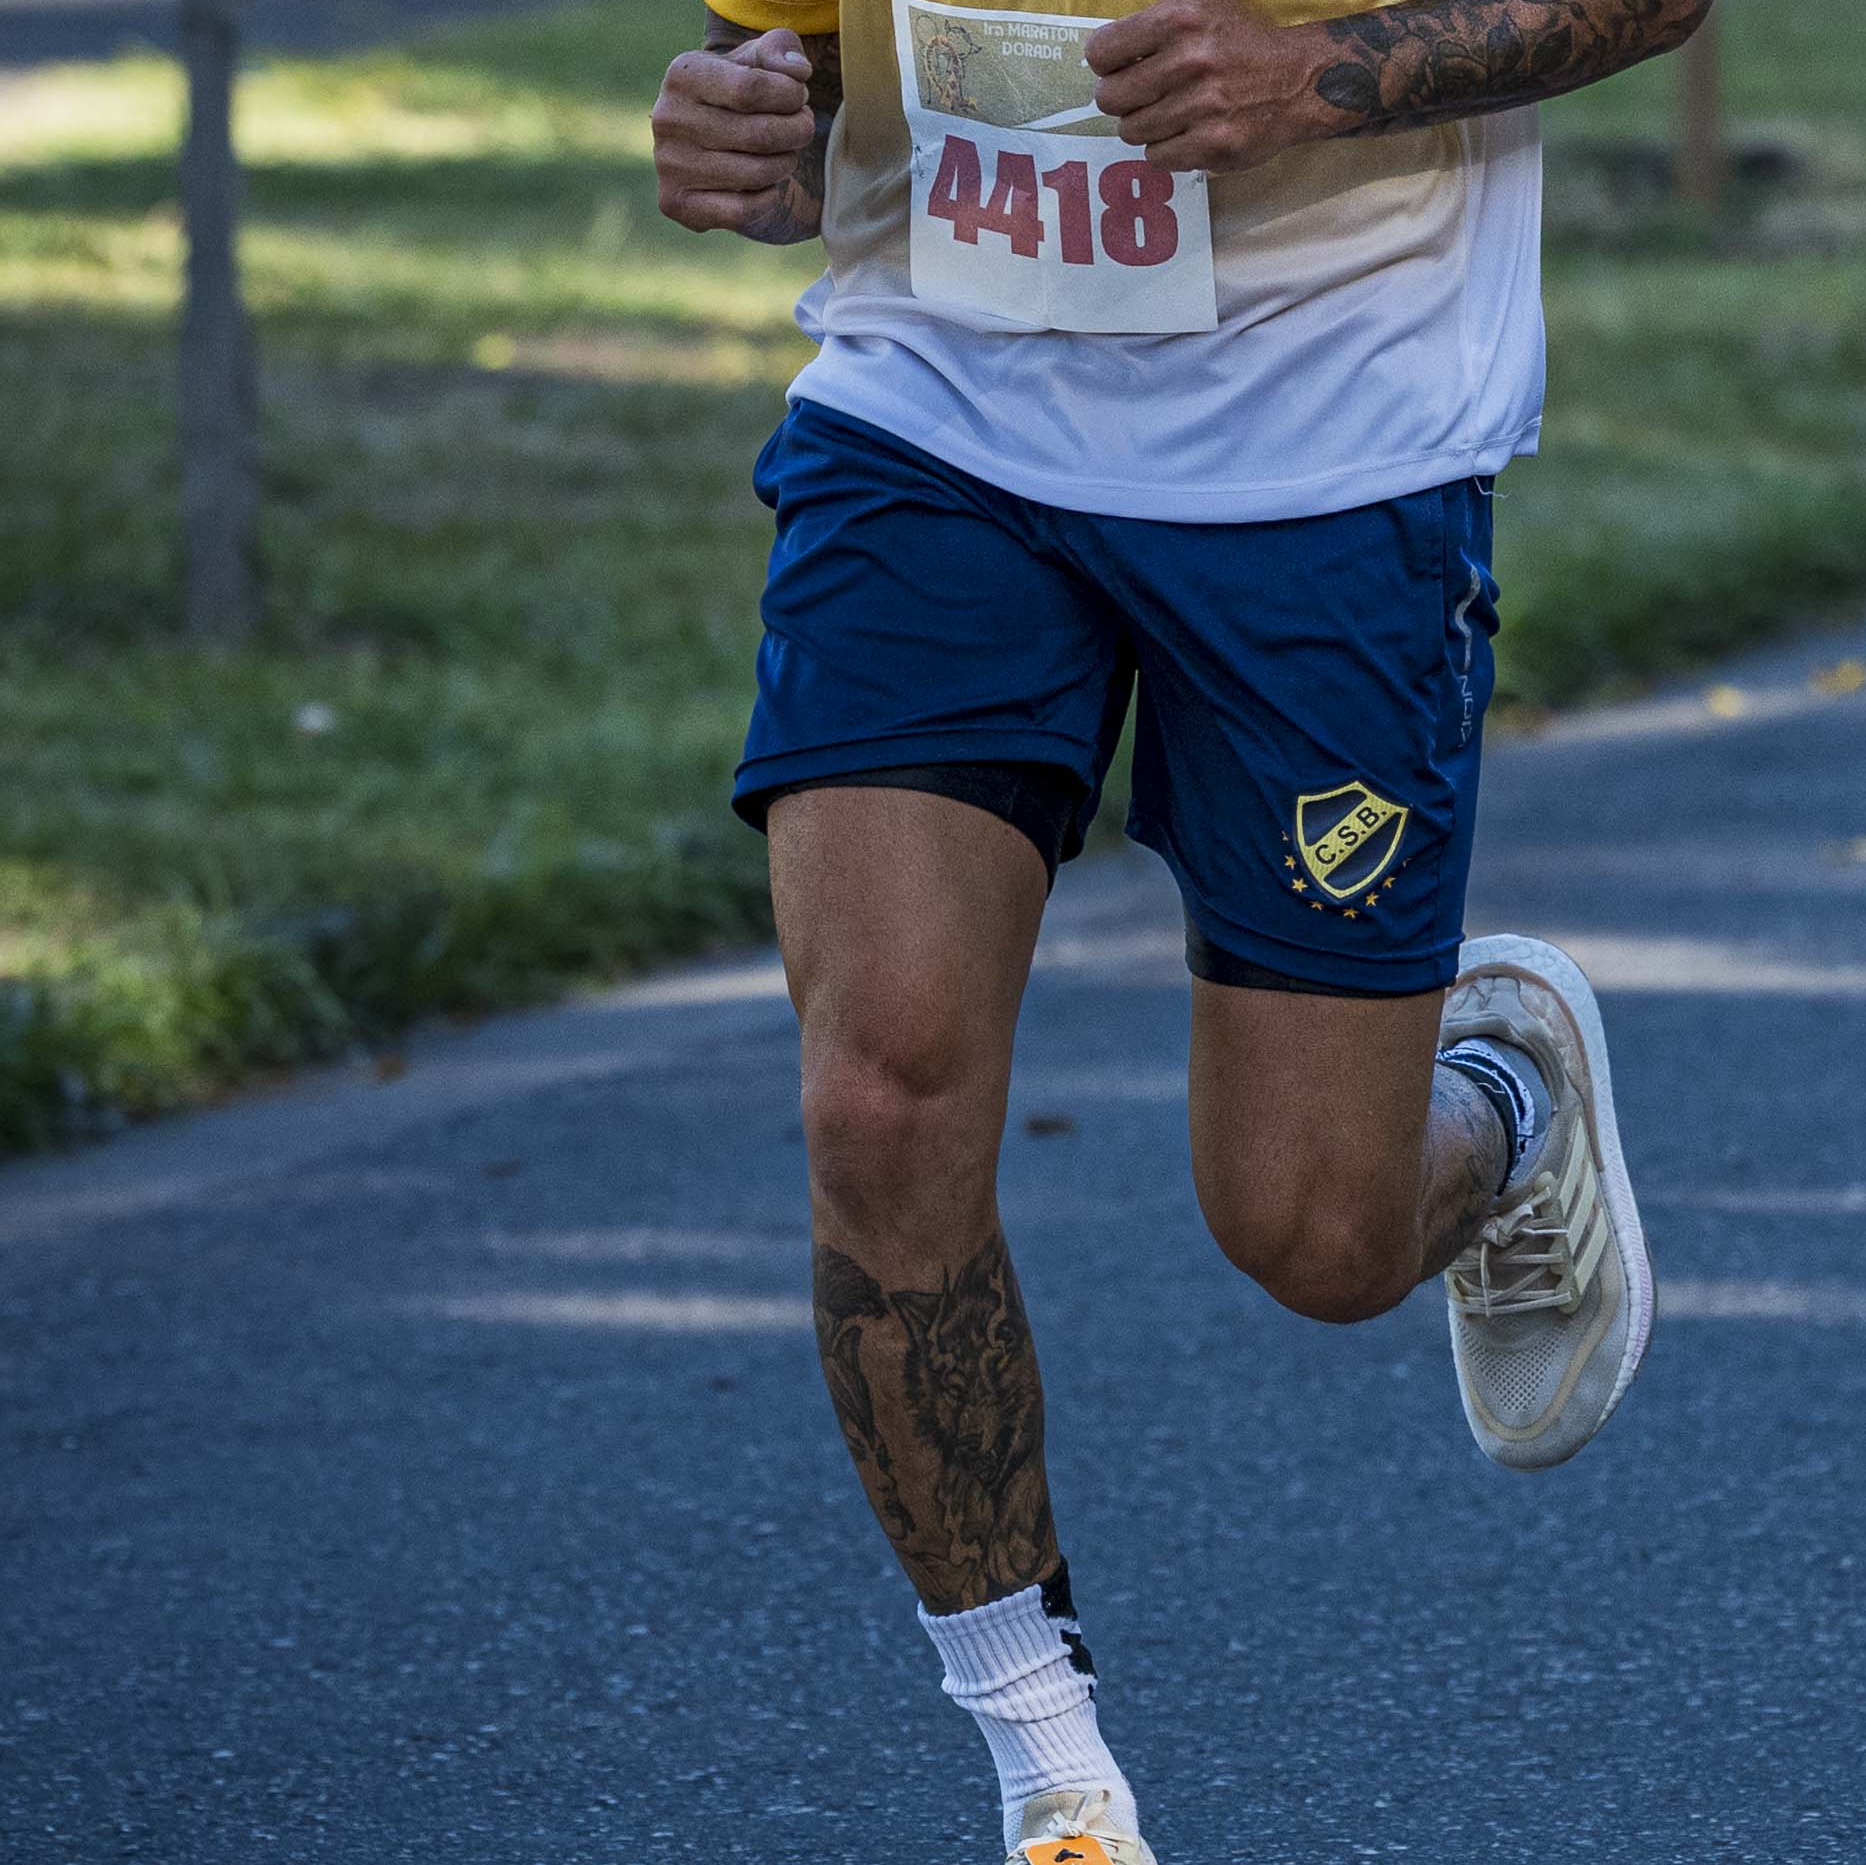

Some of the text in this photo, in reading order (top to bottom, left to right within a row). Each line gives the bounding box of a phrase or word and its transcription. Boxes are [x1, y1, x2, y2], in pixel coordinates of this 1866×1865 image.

[1001, 41, 1063, 61] DORADA
[1007, 22, 1080, 43] MARATON
[927, 133, 1180, 267] 4418
[1315, 806, 1388, 865] C.S.B.
